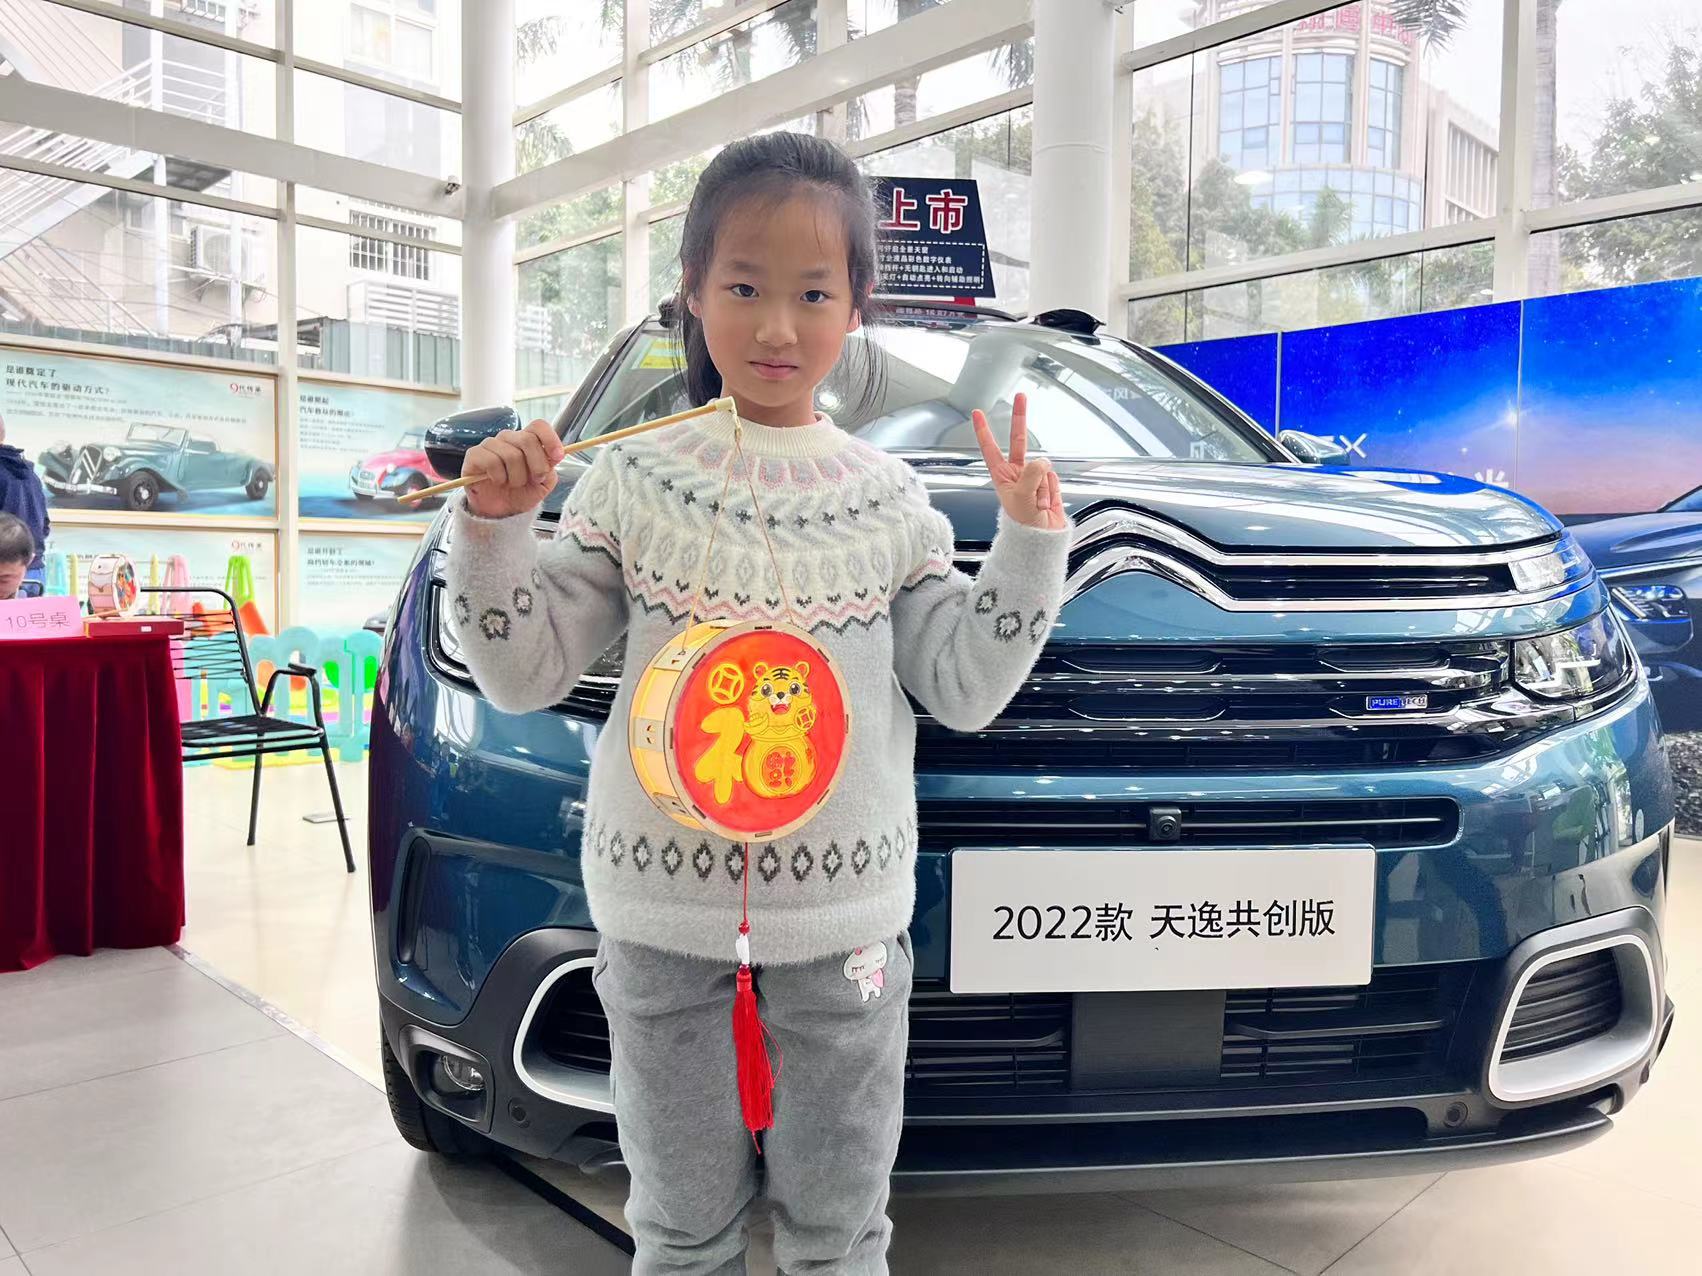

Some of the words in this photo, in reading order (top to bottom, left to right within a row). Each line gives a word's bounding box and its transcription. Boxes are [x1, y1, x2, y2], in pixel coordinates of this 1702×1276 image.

[878, 188, 968, 234] 上市
[7, 612, 71, 630] 10号桌
[992, 902, 1134, 942] 2022款
[1148, 898, 1336, 939] 天逸共创版
